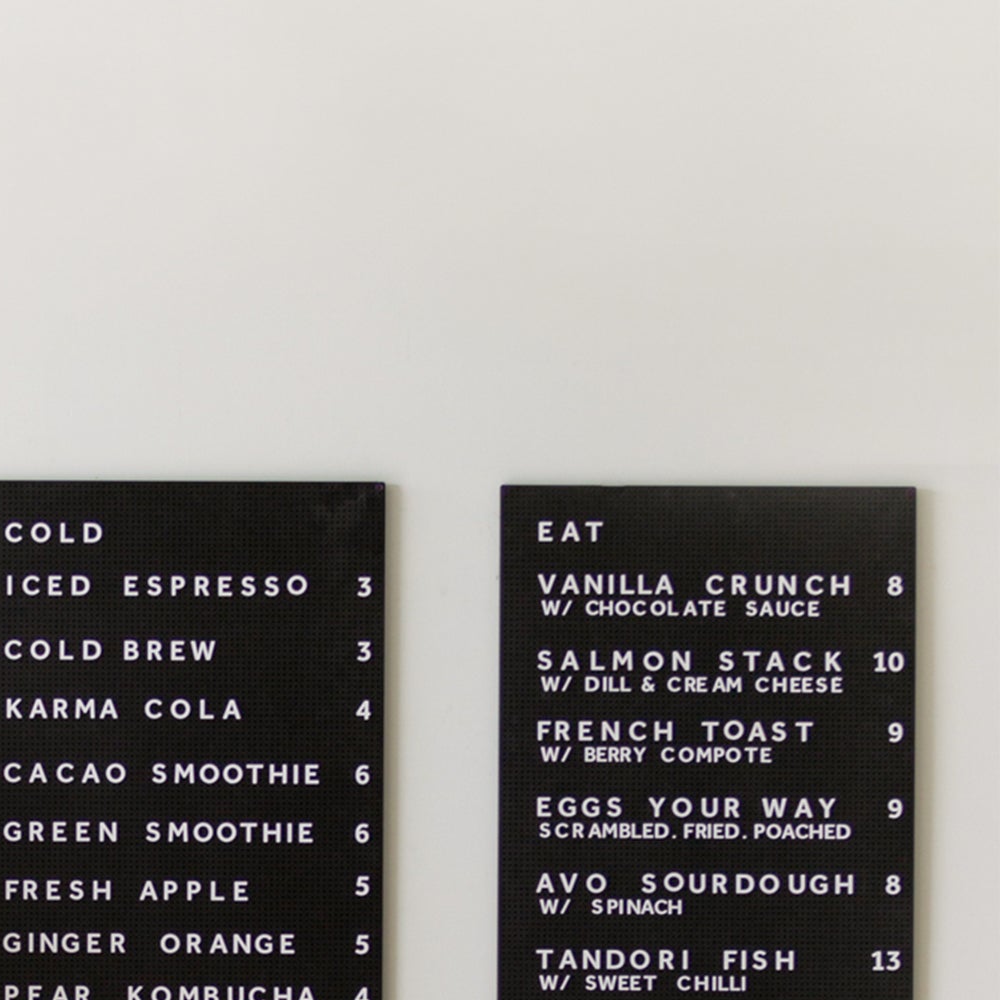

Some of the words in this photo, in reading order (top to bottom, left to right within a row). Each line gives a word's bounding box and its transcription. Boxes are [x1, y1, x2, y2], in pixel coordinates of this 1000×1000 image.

[4, 521, 103, 544] COLD
[537, 520, 604, 543] EAT
[6, 574, 91, 597] ICED
[123, 574, 308, 597] ESPRESSO
[356, 576, 372, 598] 3
[537, 573, 674, 596] VANILLA
[705, 574, 852, 596] CRUNCH
[886, 575, 904, 597] 8
[540, 599, 573, 617] W/
[585, 599, 727, 617] CHOCOLATE
[745, 600, 820, 618] SAUCE
[4, 639, 102, 661] COLD
[123, 639, 216, 662] BREW
[356, 640, 372, 662] 3
[537, 649, 691, 672] SALMON
[718, 650, 842, 673] STACK
[872, 651, 905, 673] 10
[540, 675, 573, 693] W/
[584, 675, 632, 693] DILL
[640, 675, 656, 693] &
[666, 676, 743, 693] CREAM
[754, 676, 844, 694] CHEESE
[5, 697, 119, 720] KARMA
[144, 698, 242, 720] COLA
[355, 699, 372, 721] 4
[536, 720, 675, 742] FRENCH
[700, 719, 814, 743] TOAST
[887, 721, 904, 744] 9
[540, 745, 572, 763] W/
[583, 746, 647, 763] BERRY
[660, 746, 773, 764] COMPOTE
[3, 762, 126, 784] CACAO
[151, 762, 320, 785] SMOOTHIE
[354, 764, 370, 786] 6
[536, 796, 622, 818] EGGS
[648, 796, 740, 819] YOUR
[761, 797, 836, 819] WAY
[887, 798, 903, 820] 9
[3, 820, 118, 843] GREEN
[145, 821, 314, 844] SMOOTHIE
[354, 822, 370, 844] 6
[753, 823, 852, 840] POACHED
[5, 879, 112, 901] FRESH
[139, 880, 249, 902] APPLE
[354, 875, 370, 897] 5
[535, 872, 607, 894] AVO
[641, 871, 854, 895] SOURDOUGH
[884, 874, 902, 896] 8
[539, 898, 571, 915] W/
[591, 898, 683, 916] SPINACH
[2, 932, 126, 954] GINGER
[159, 932, 296, 955] ORANGE
[354, 934, 370, 955] 5
[535, 948, 689, 971] TANDORI
[723, 949, 795, 971] FISH
[871, 950, 901, 972] 13
[538, 974, 571, 991] W/
[585, 974, 658, 992] SWEET
[676, 975, 747, 992] CHILLI
